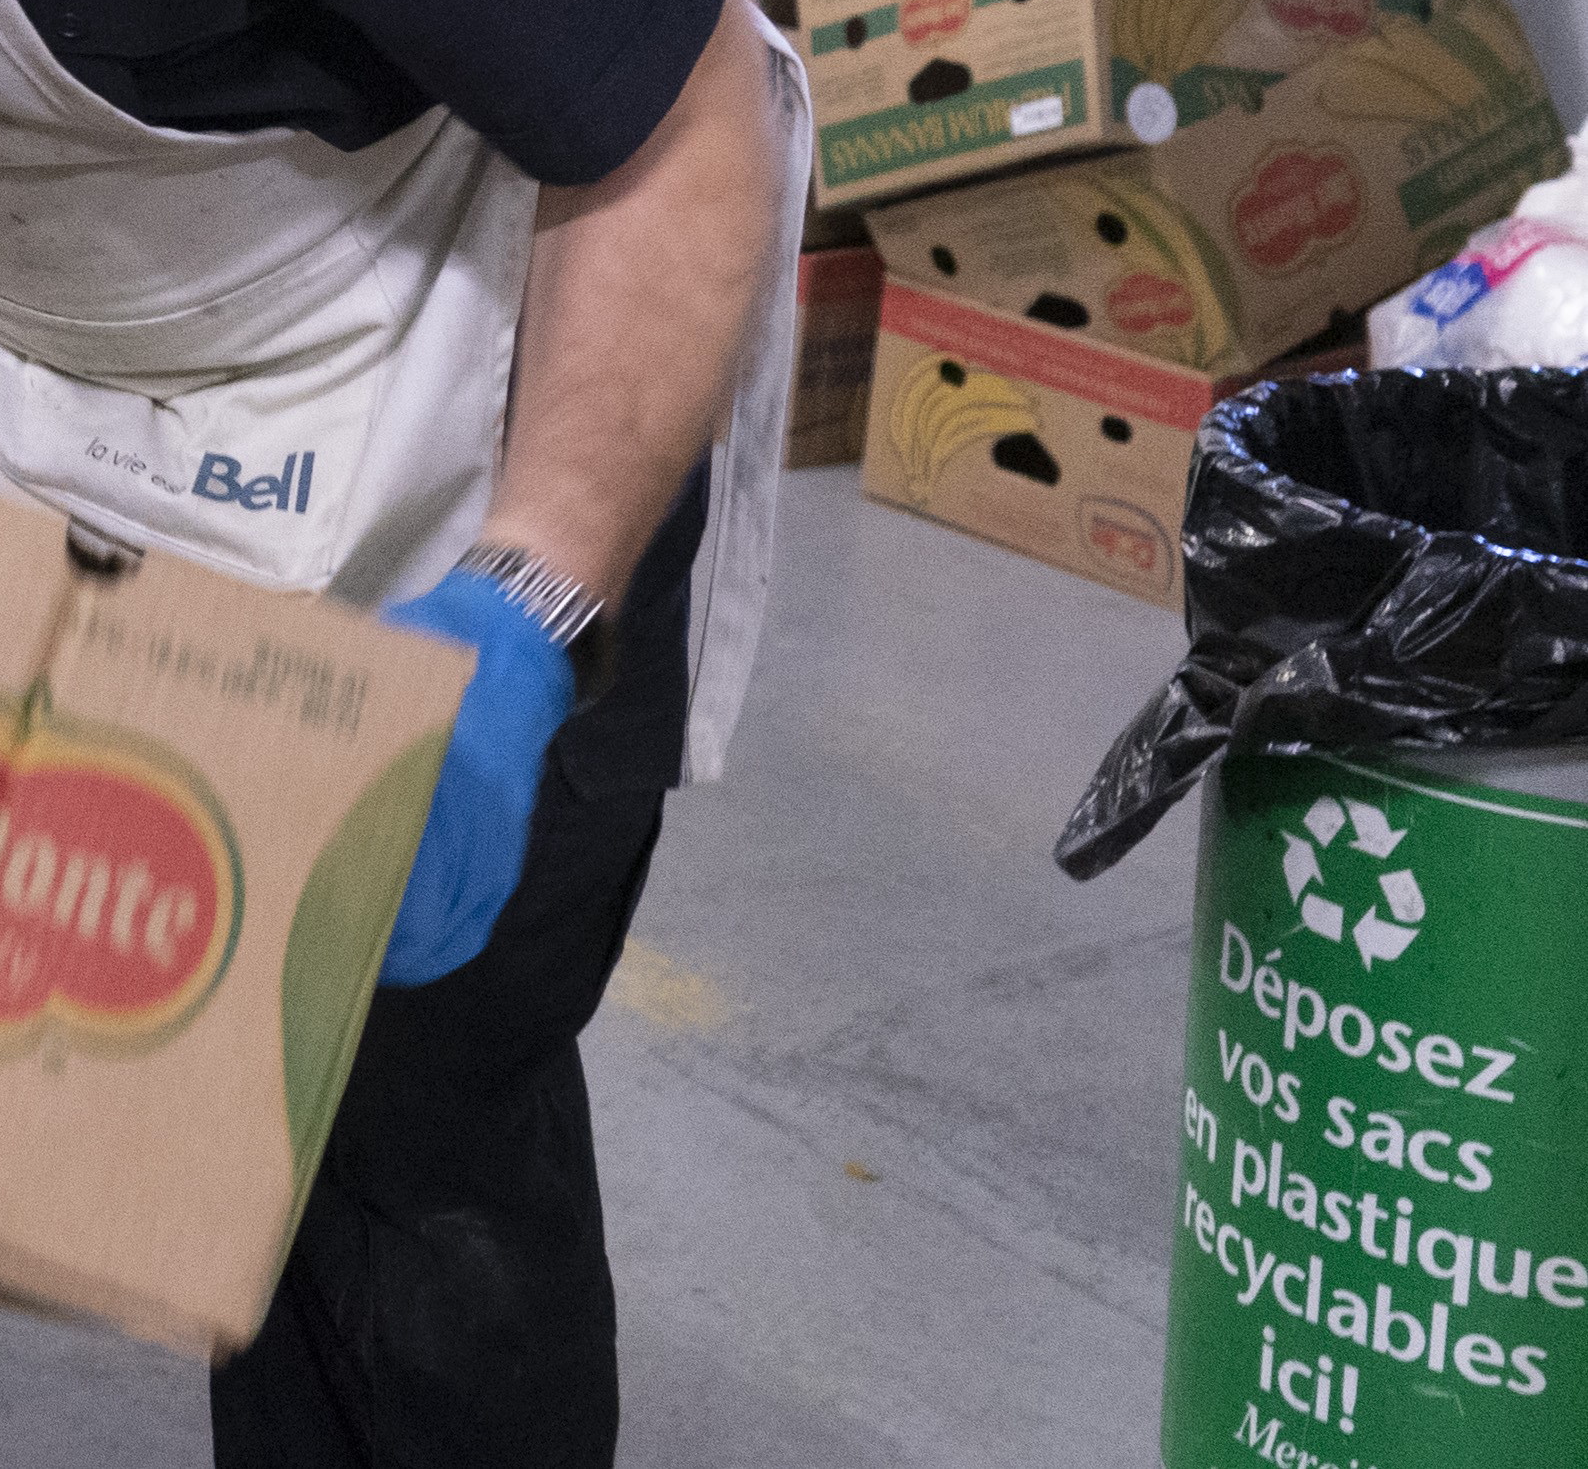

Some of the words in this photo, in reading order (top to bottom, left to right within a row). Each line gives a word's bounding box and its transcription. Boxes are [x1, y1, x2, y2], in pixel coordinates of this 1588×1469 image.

[191, 450, 316, 515] Bell
[1220, 919, 1518, 1104] Déposez
[1184, 1085, 1218, 1163] en
[1231, 1137, 1588, 1310] plastique
[1217, 1029, 1302, 1124] vos
[1324, 1093, 1496, 1193] sacs
[1184, 1180, 1550, 1396] recyclables
[1259, 1325, 1361, 1435] ici!
